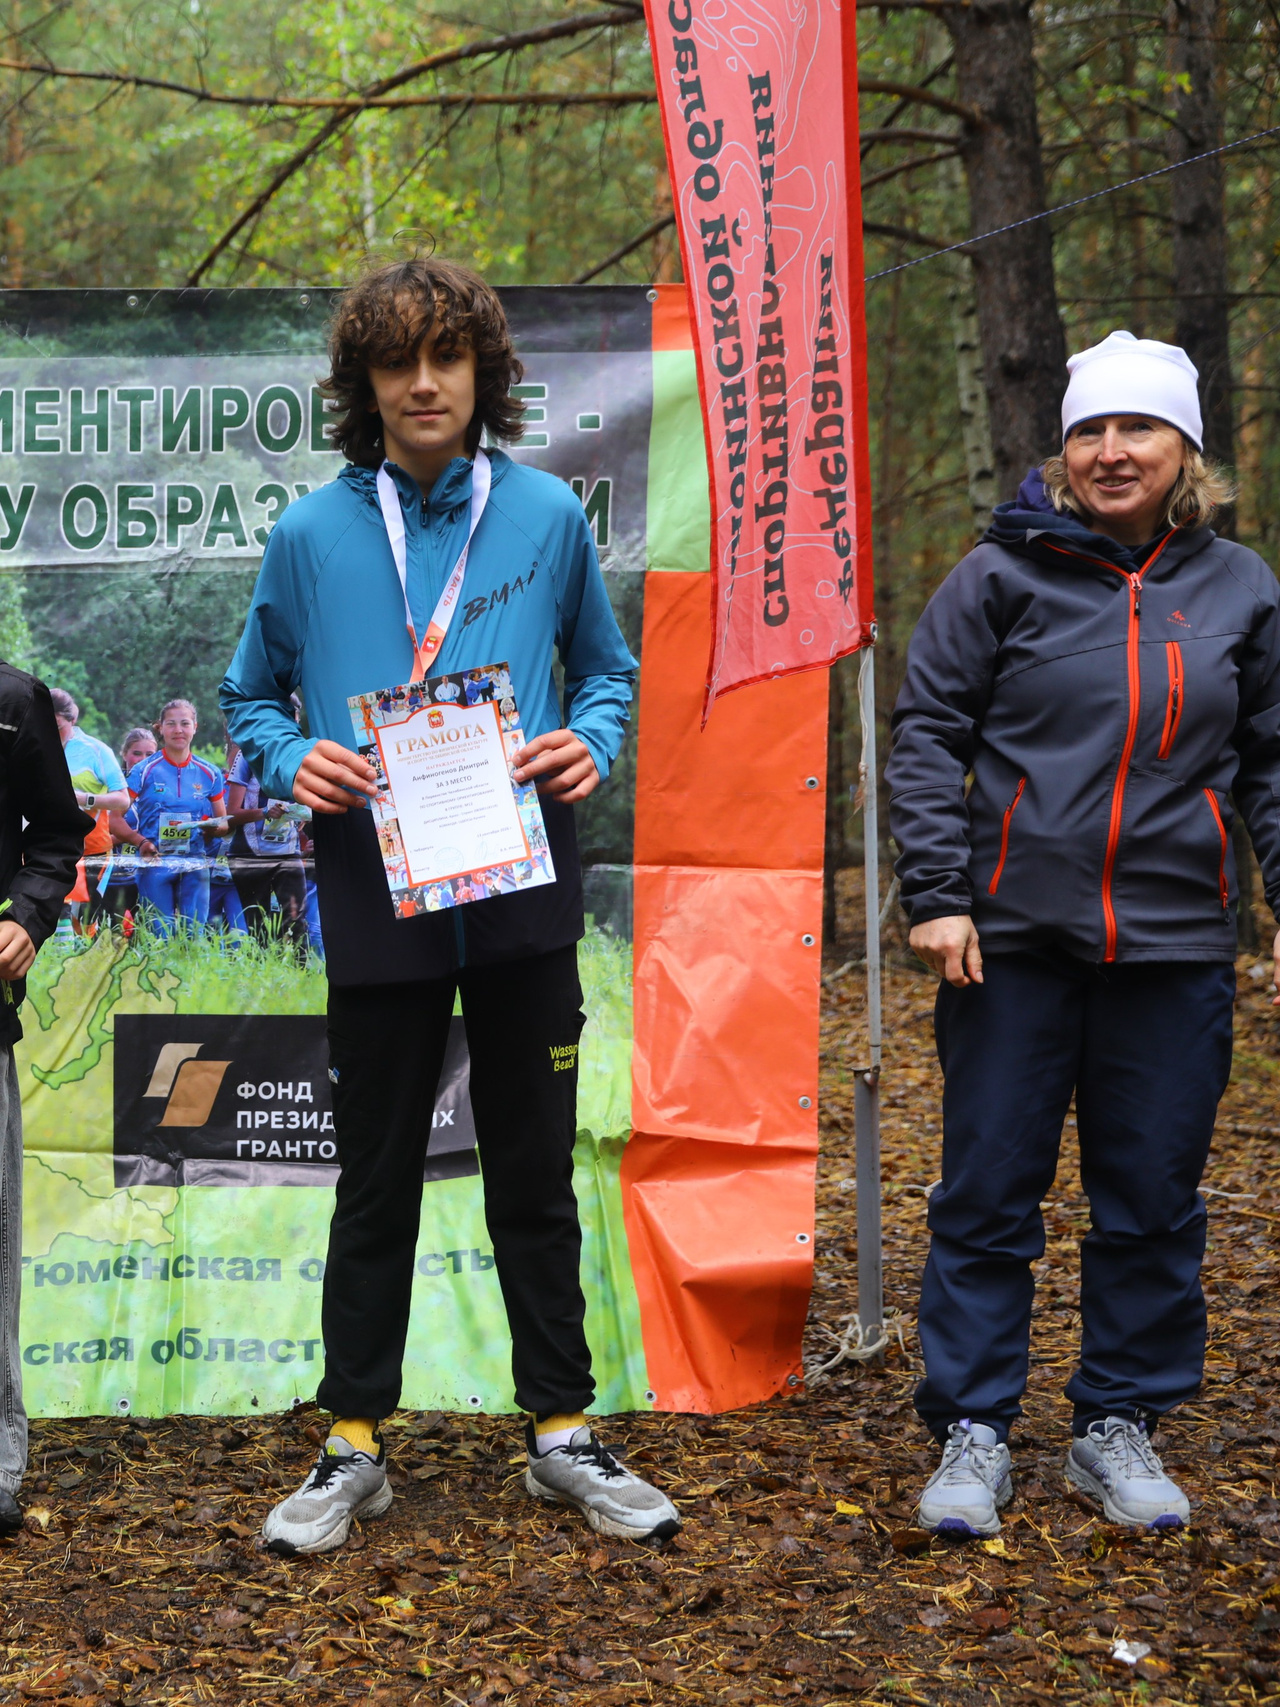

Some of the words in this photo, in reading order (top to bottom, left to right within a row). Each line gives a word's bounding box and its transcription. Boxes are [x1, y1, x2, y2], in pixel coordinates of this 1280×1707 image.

[394, 723, 486, 755] ГРАМОТА
[458, 758, 489, 773] Дмитрий
[450, 775, 472, 785] МЕСТО
[236, 1081, 313, 1103] ФОНД
[236, 1139, 337, 1158] ГРАНТО
